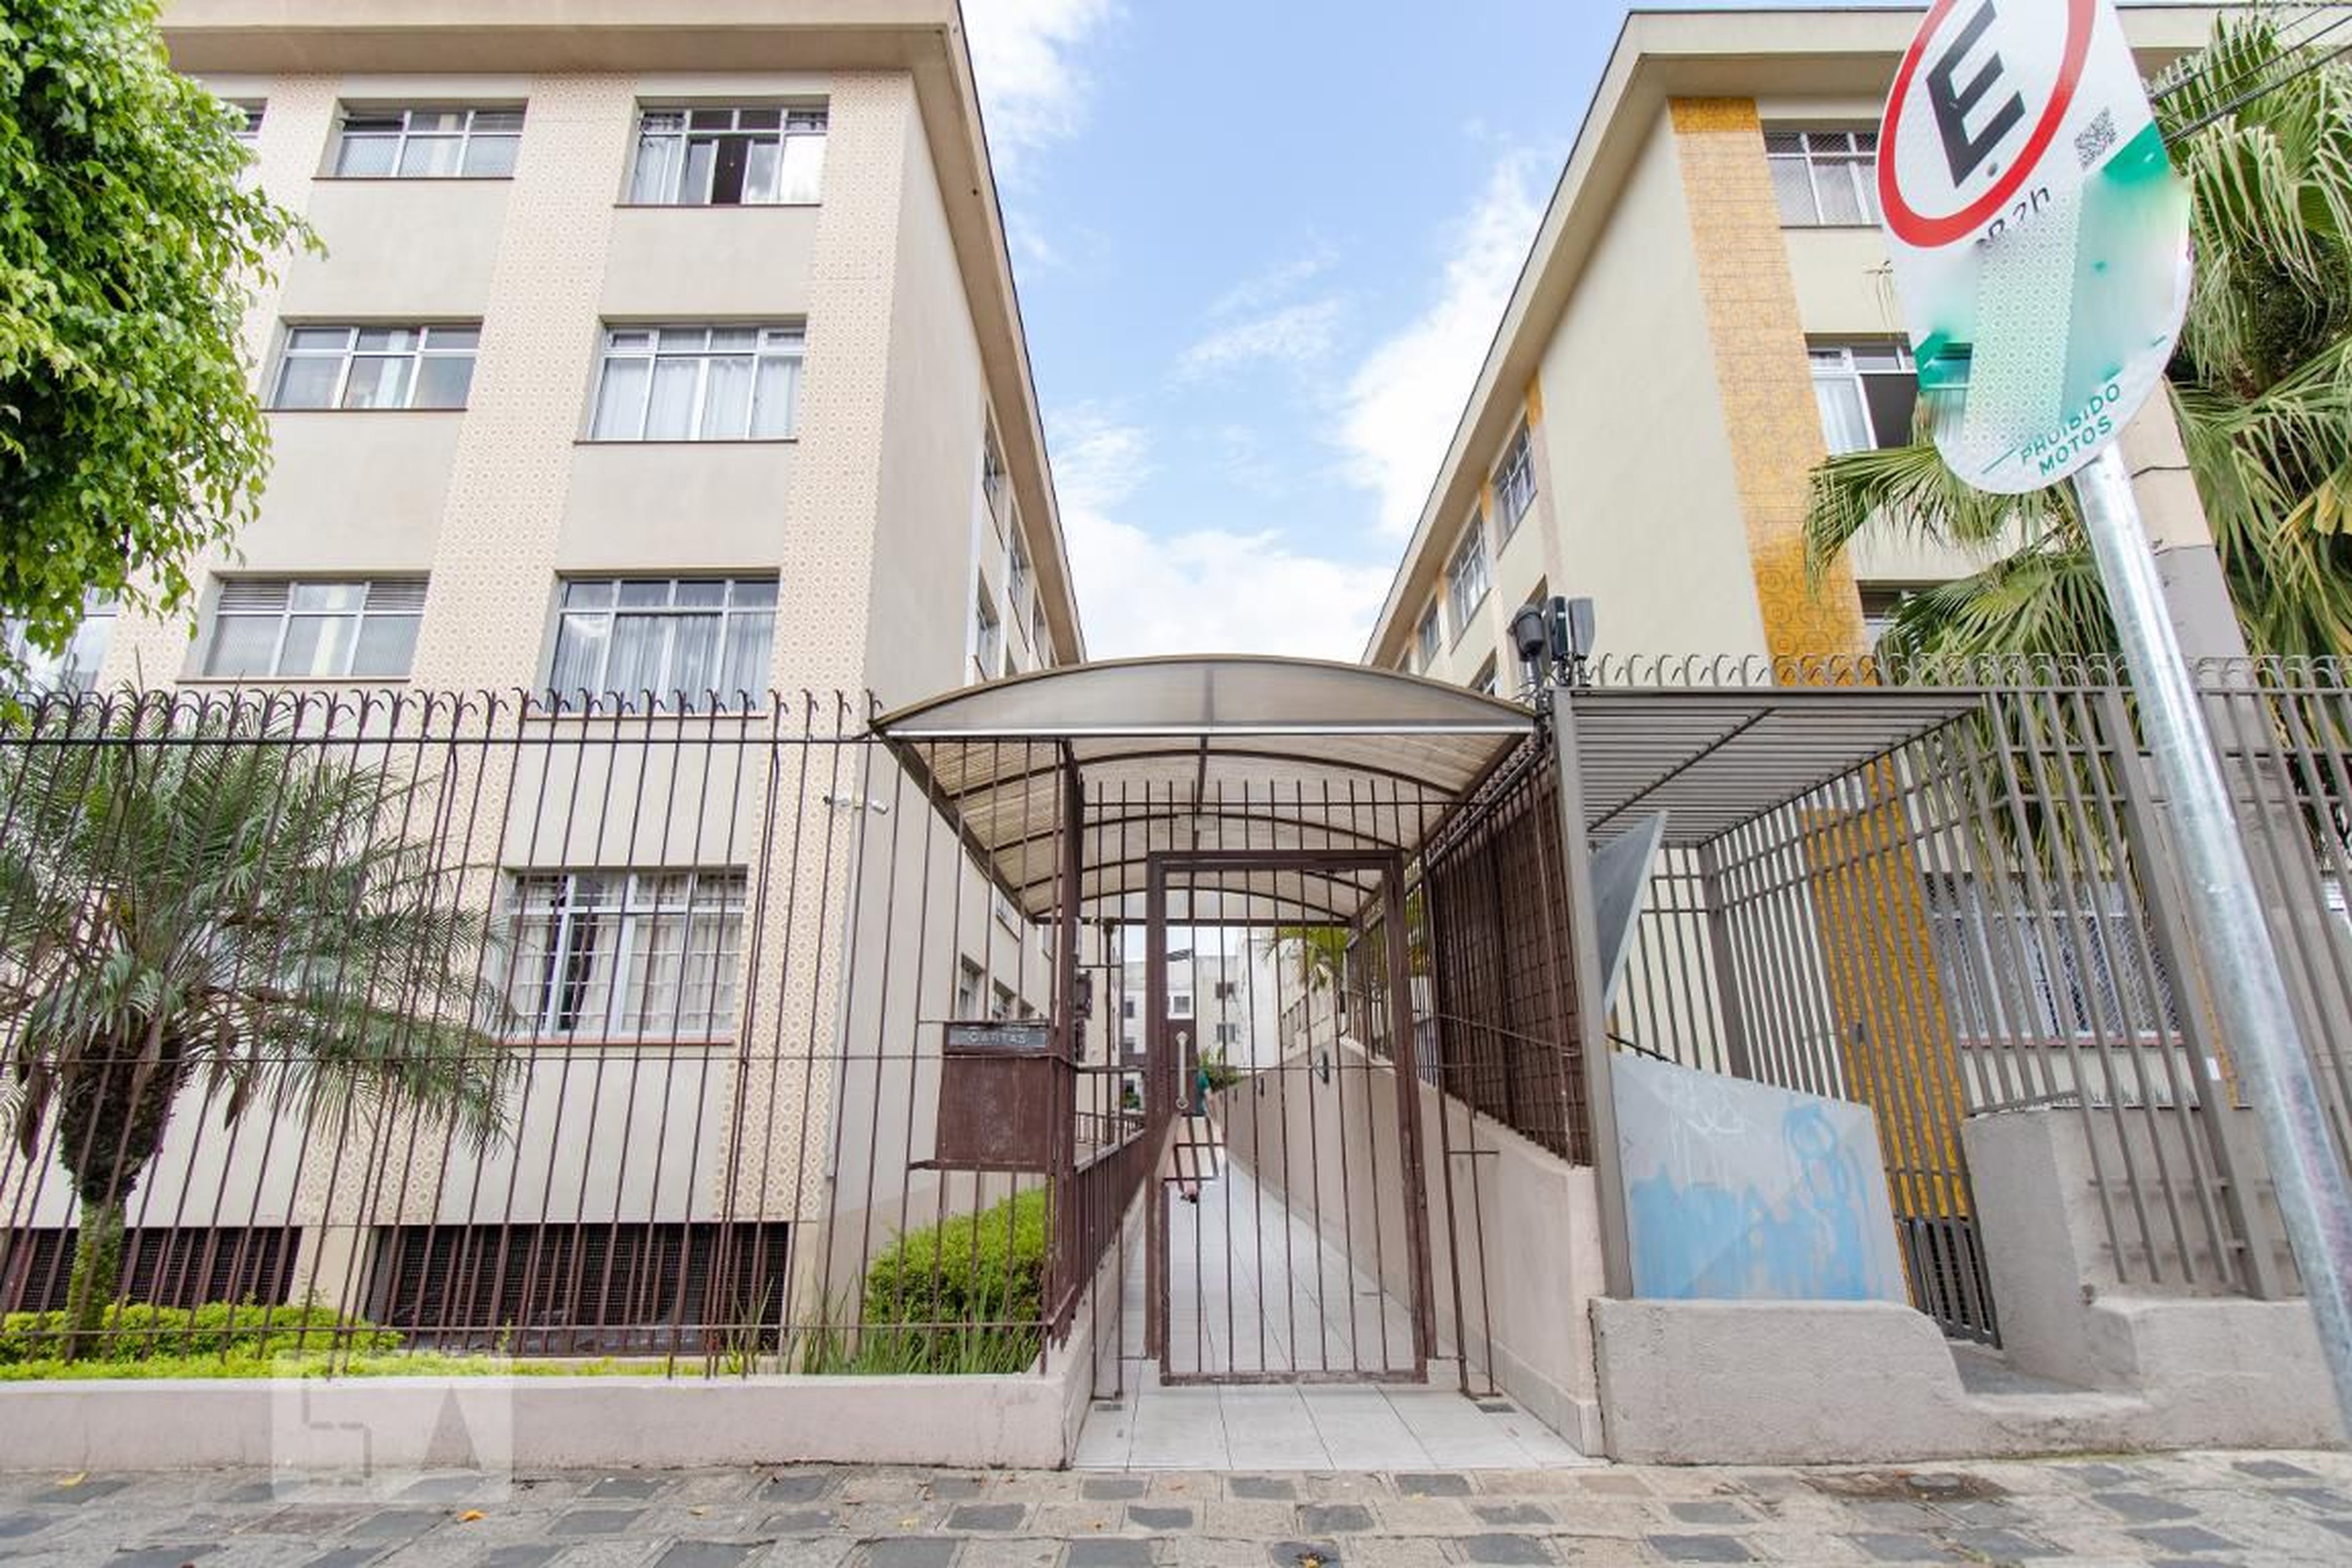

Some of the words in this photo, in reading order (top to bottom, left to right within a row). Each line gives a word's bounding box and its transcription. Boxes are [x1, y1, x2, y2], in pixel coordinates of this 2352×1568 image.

[1926, 0, 2026, 189] E
[2039, 415, 2113, 477] MOTOS
[968, 1031, 1027, 1044] CARTAS
